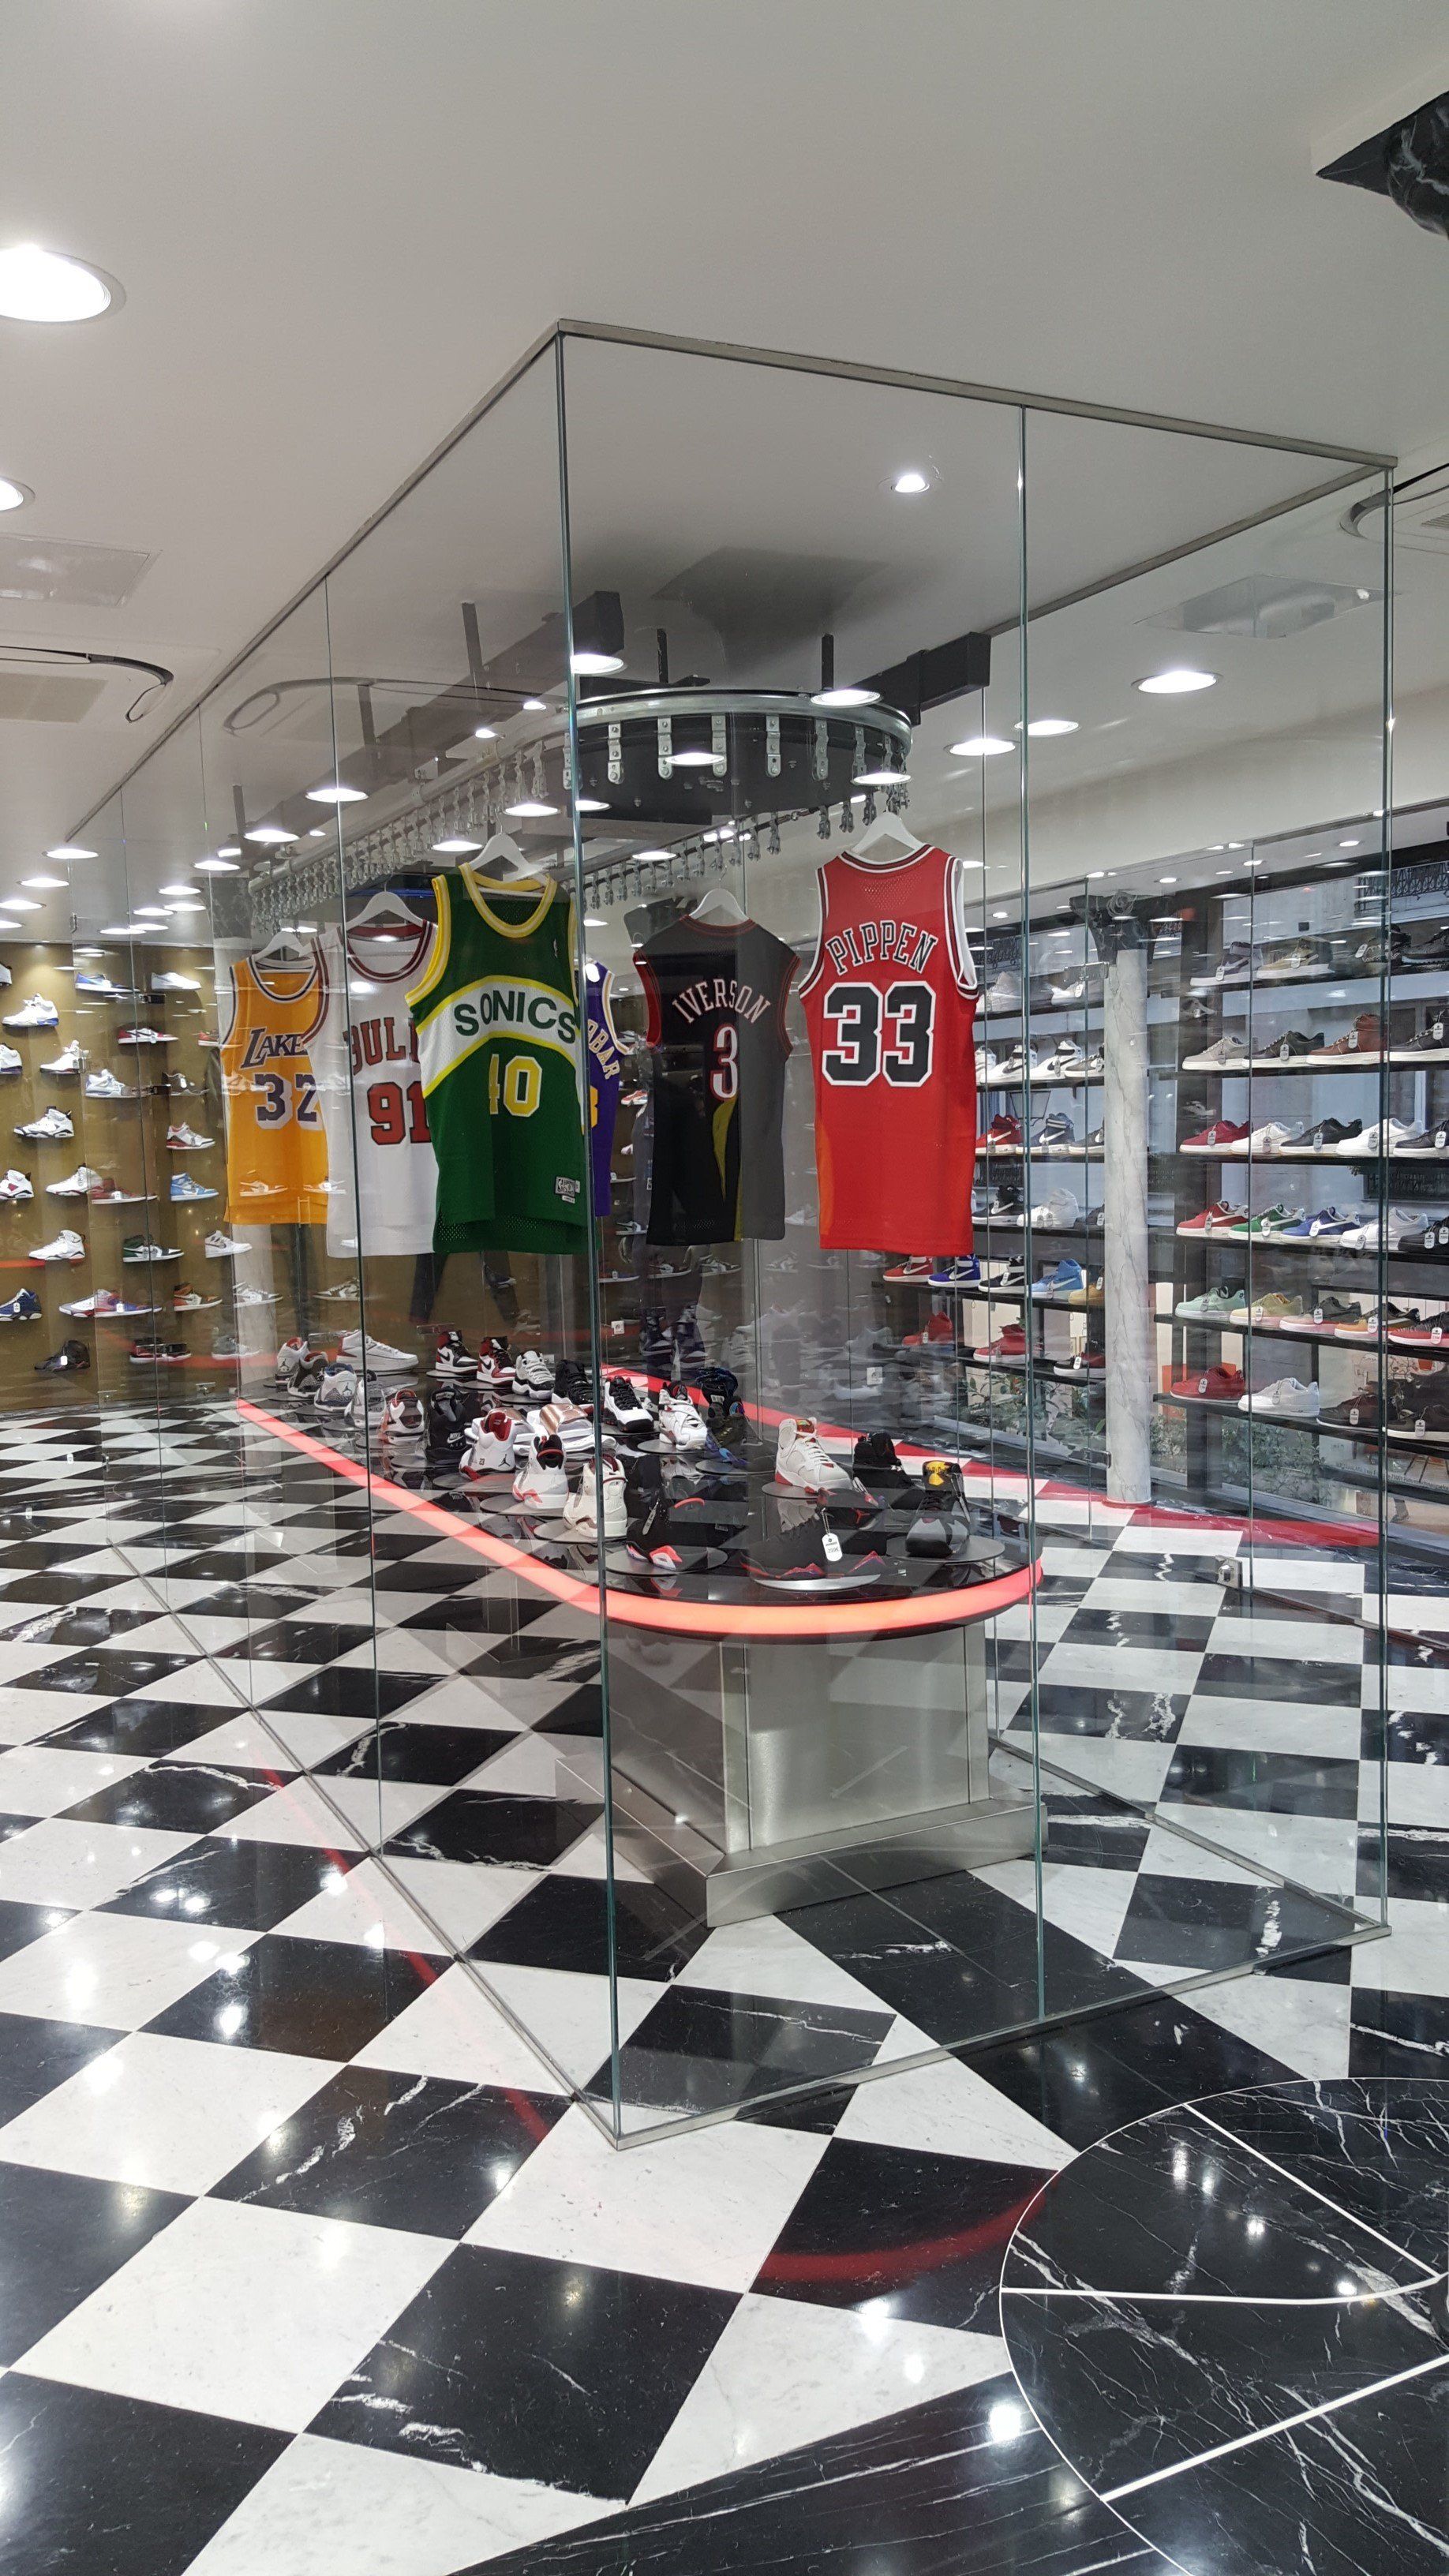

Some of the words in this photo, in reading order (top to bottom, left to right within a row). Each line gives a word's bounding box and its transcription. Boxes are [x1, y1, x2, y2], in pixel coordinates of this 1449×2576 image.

[825, 920, 939, 976] PIPPEN
[454, 990, 577, 1044] SONICS
[672, 978, 771, 1024] IVERSON
[710, 1023, 739, 1102] 3
[822, 980, 937, 1088] 33
[253, 1072, 324, 1130] 32
[367, 1081, 432, 1145] 91
